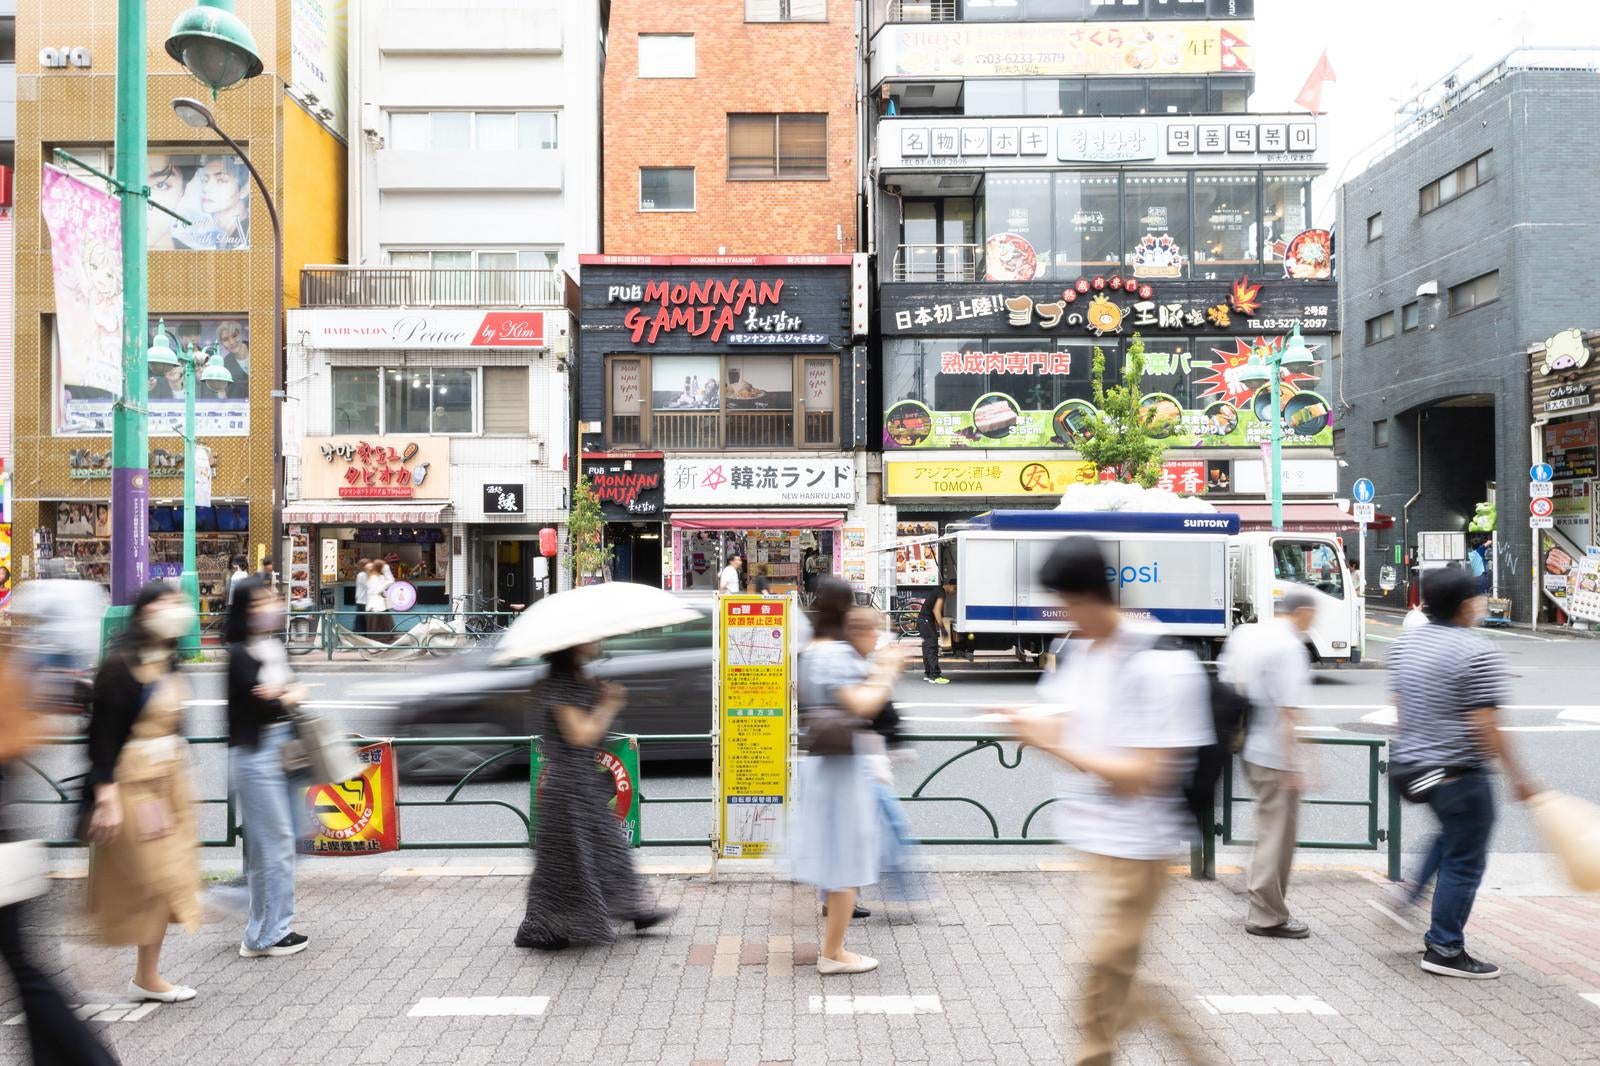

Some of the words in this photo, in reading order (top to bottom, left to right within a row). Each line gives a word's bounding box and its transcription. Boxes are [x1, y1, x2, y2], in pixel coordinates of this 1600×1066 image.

[1069, 28, 1123, 49] さくら
[1173, 128, 1311, 148] 명품떡볶이
[608, 285, 642, 301] PUB
[643, 278, 784, 316] MONNAN
[1303, 306, 1328, 316] 2号店
[323, 327, 351, 335] HAIR
[353, 327, 388, 335] SALON
[392, 316, 465, 344] Peace
[482, 325, 496, 344] by
[499, 320, 535, 338] Kim
[624, 306, 734, 344] GAMJA
[940, 351, 1072, 376] 熟成肉専門店
[588, 467, 605, 475] PUB
[673, 464, 698, 490] 新
[731, 466, 850, 489] 韓流ランド
[593, 473, 658, 492] MONNAN
[933, 481, 983, 492] TOMOYA
[1184, 519, 1229, 530] SUNTORY
[1104, 562, 1158, 588] epsi
